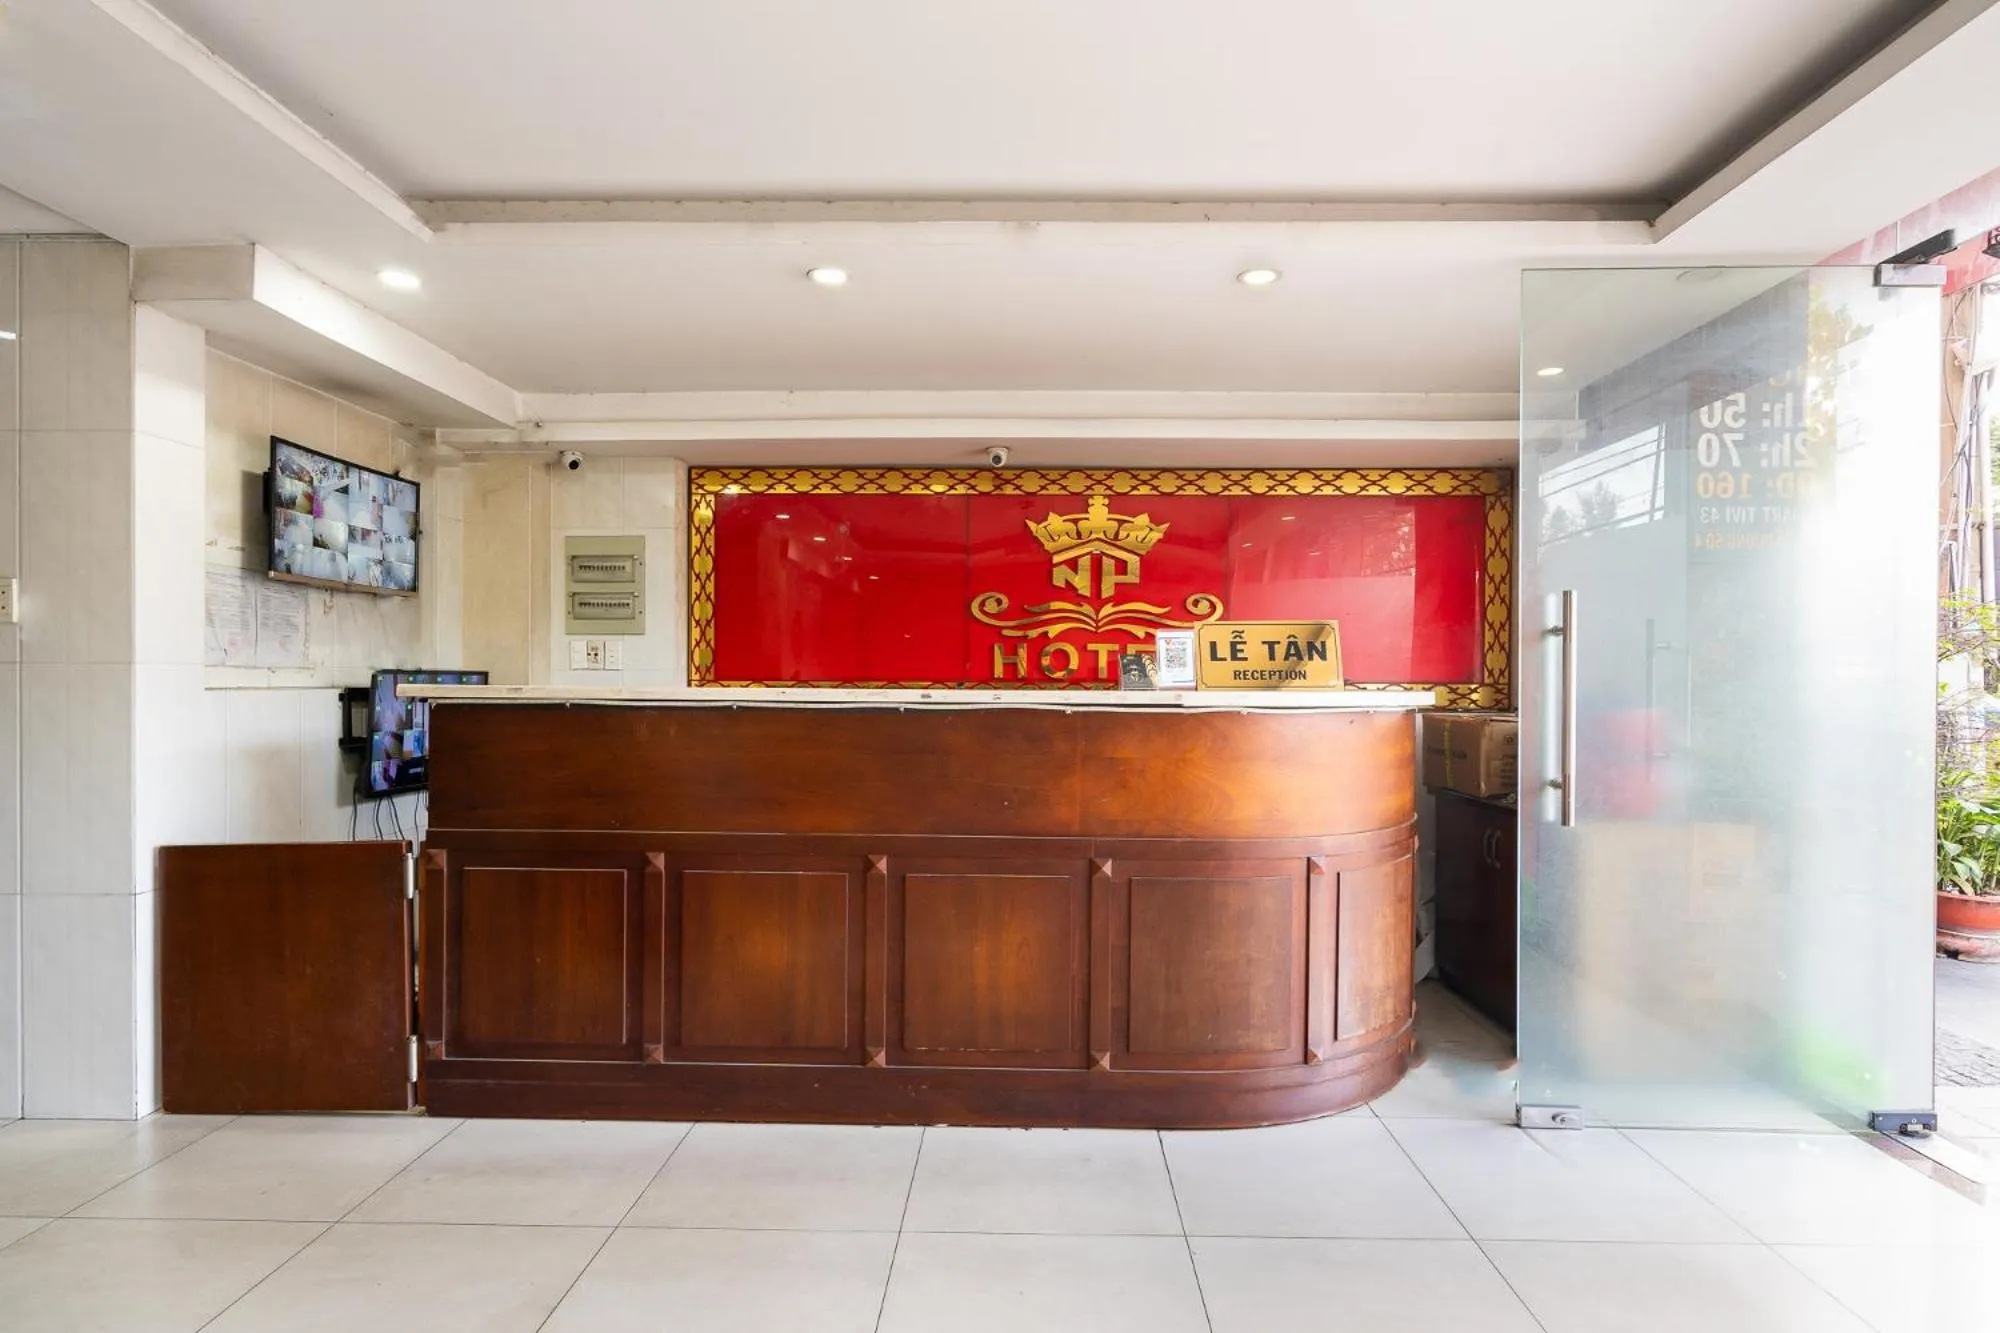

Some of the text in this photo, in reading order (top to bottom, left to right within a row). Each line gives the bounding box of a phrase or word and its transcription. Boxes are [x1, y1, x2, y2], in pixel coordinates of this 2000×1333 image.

[1052, 548, 1141, 599] NP
[993, 642, 1157, 680] HOT
[1209, 630, 1328, 662] LỄ TÂN
[1233, 669, 1307, 681] RECEPTION
